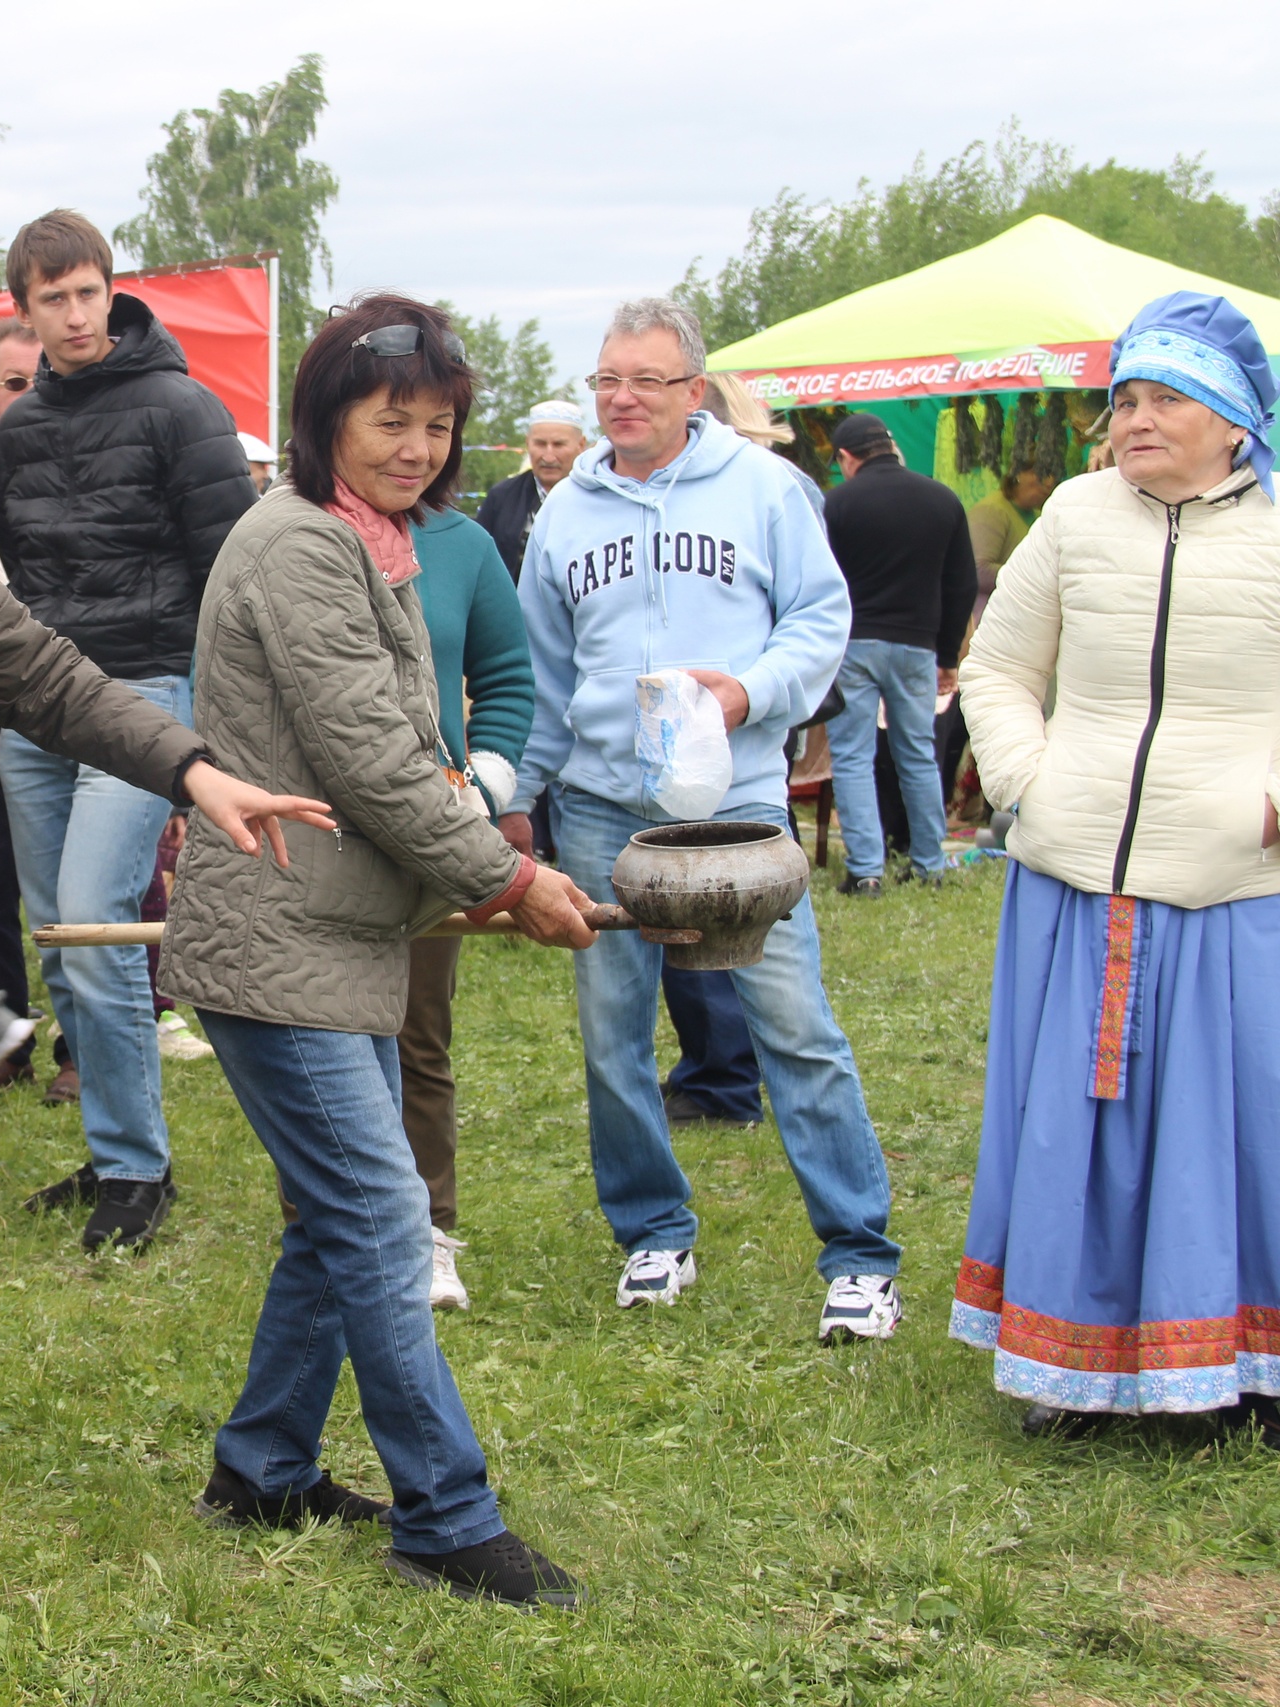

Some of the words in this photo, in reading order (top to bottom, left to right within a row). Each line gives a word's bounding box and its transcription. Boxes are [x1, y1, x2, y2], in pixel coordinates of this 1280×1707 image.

[840, 362, 956, 392] СЕЛЬСКОЕ
[954, 352, 1088, 383] ПОСЕЛЕНИЕ
[566, 533, 635, 606] CAPE
[652, 530, 717, 579] COD
[721, 548, 735, 580] MA
